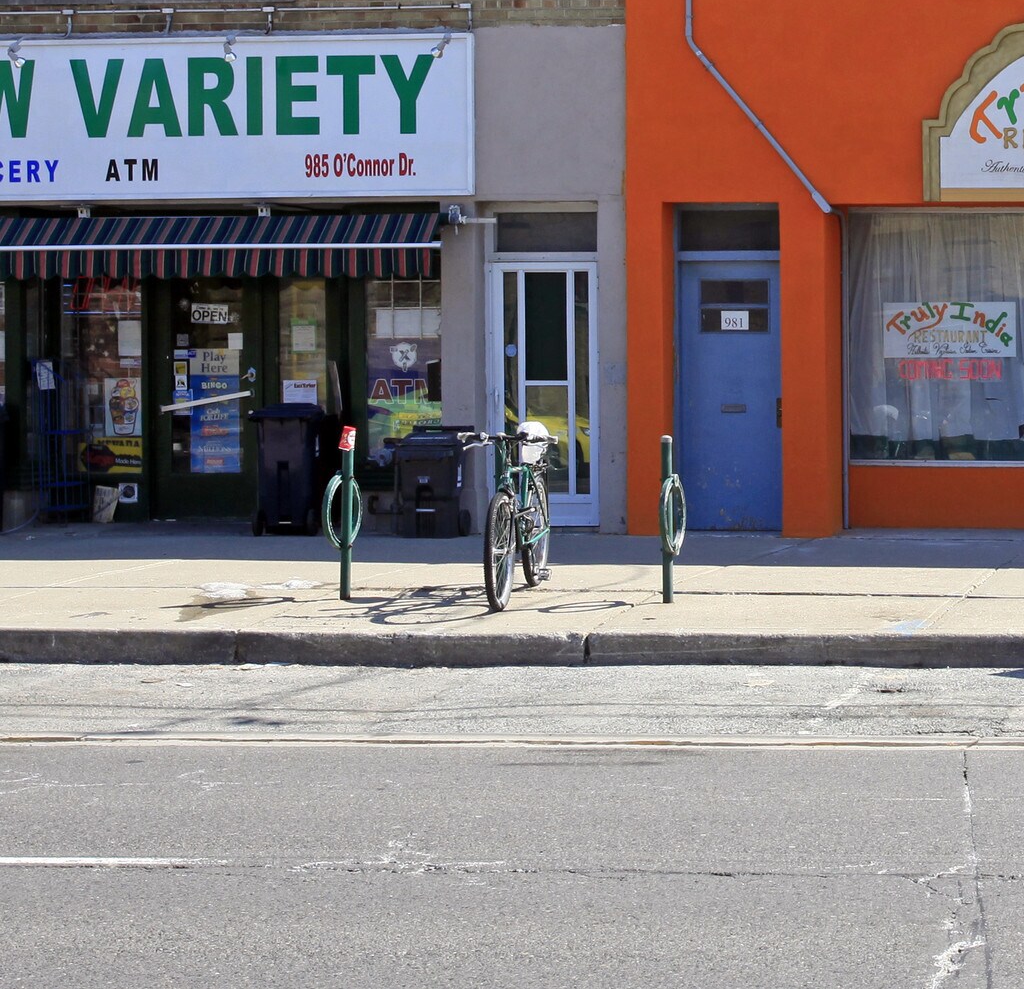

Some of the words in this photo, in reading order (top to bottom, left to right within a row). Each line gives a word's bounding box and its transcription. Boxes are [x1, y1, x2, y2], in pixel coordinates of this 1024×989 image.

[69, 54, 436, 138] VARIETY
[0, 159, 59, 183] ERY
[105, 159, 159, 182] ATM
[305, 154, 329, 178] 985
[333, 153, 395, 177] O'Connor
[398, 152, 417, 176] Dr.
[192, 309, 228, 322] OPEN
[724, 317, 744, 329] 981
[886, 301, 948, 341] Truly
[949, 301, 1013, 347] India
[913, 330, 988, 344] RESTAURANT
[202, 351, 226, 364] Play
[201, 363, 228, 373] Here
[898, 358, 954, 381] COMING
[959, 358, 1003, 380] SOON
[201, 382, 228, 390] BINGO
